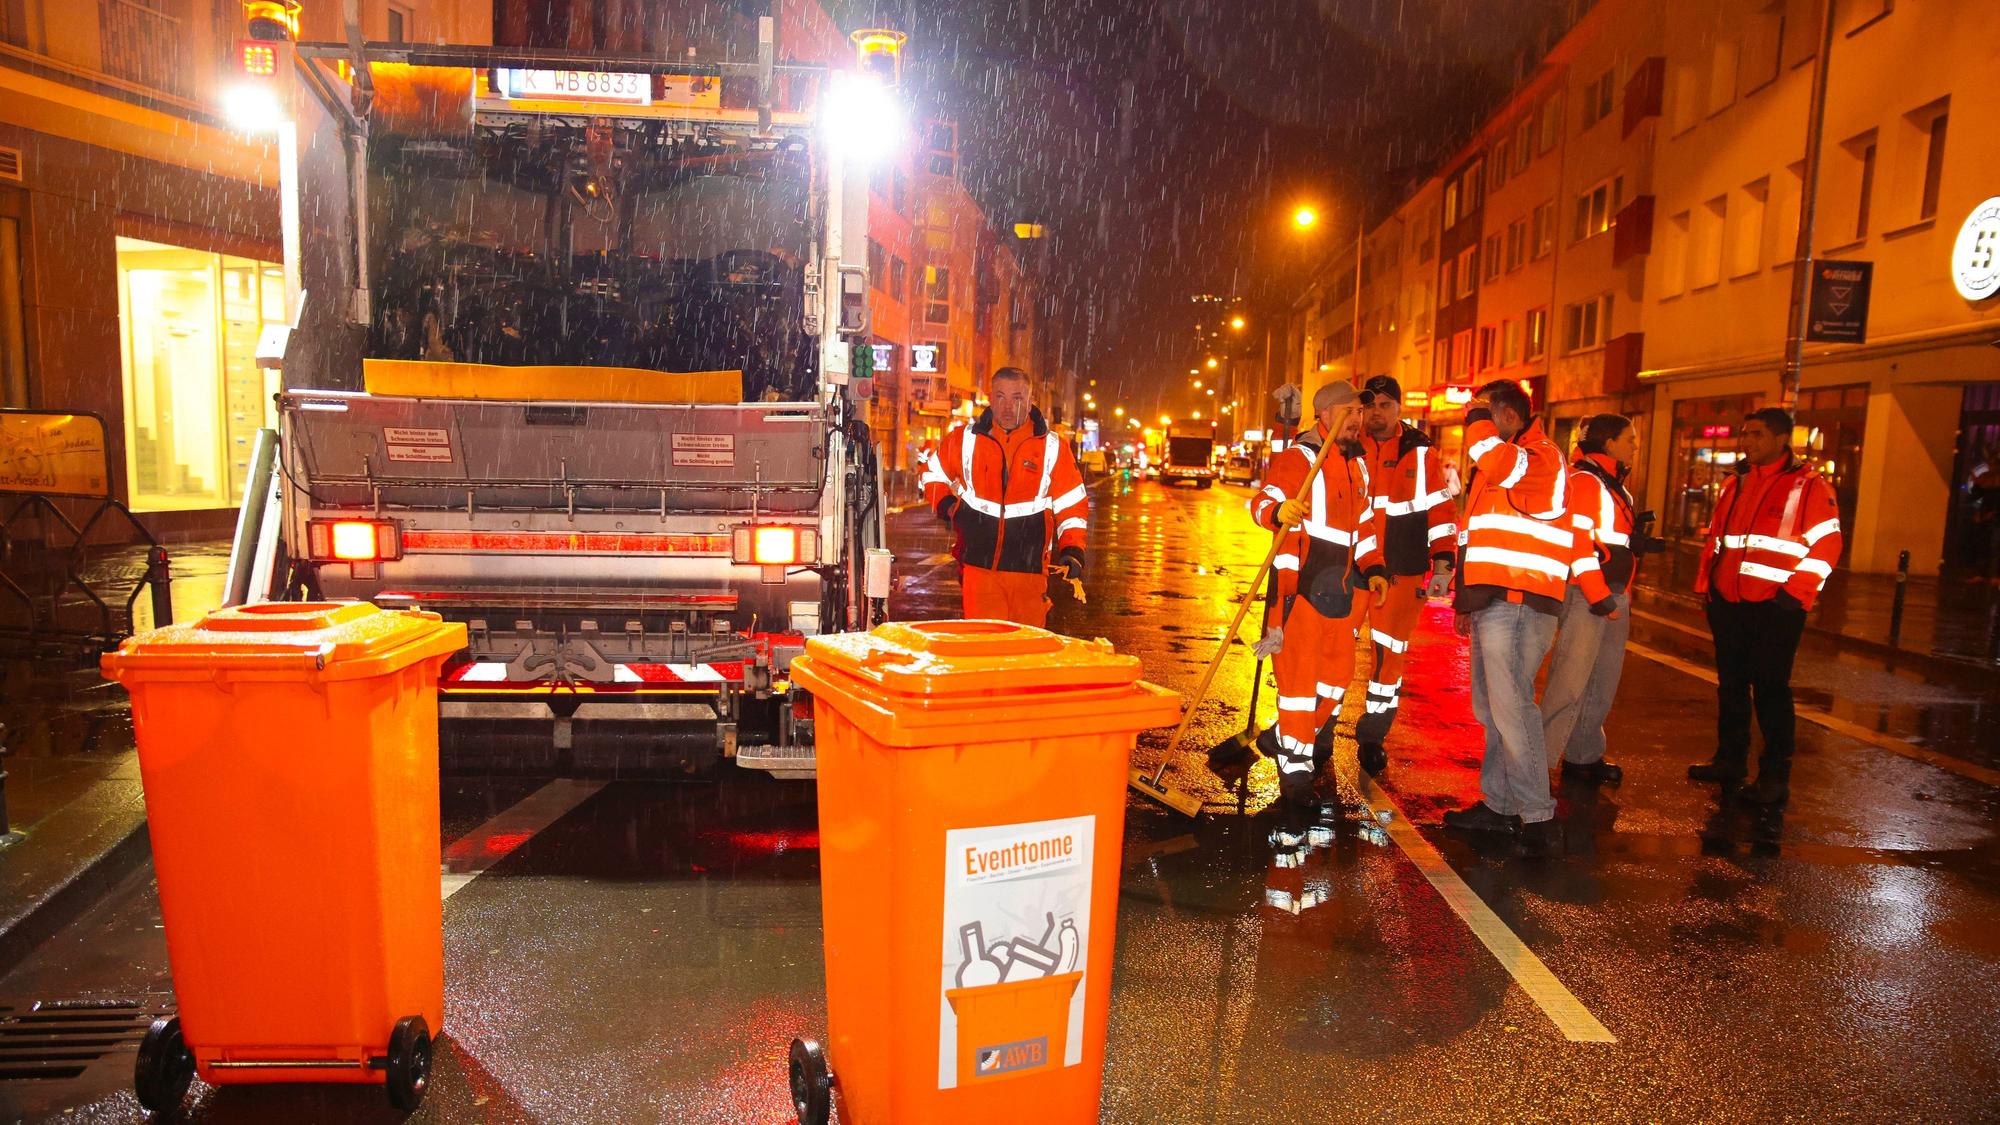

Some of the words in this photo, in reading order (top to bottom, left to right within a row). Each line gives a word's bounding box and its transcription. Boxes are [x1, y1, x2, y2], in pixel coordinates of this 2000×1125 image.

[586, 72, 638, 95] 8833
[965, 834, 1073, 875] Eventtonne
[1002, 1042, 1042, 1068] AWB
